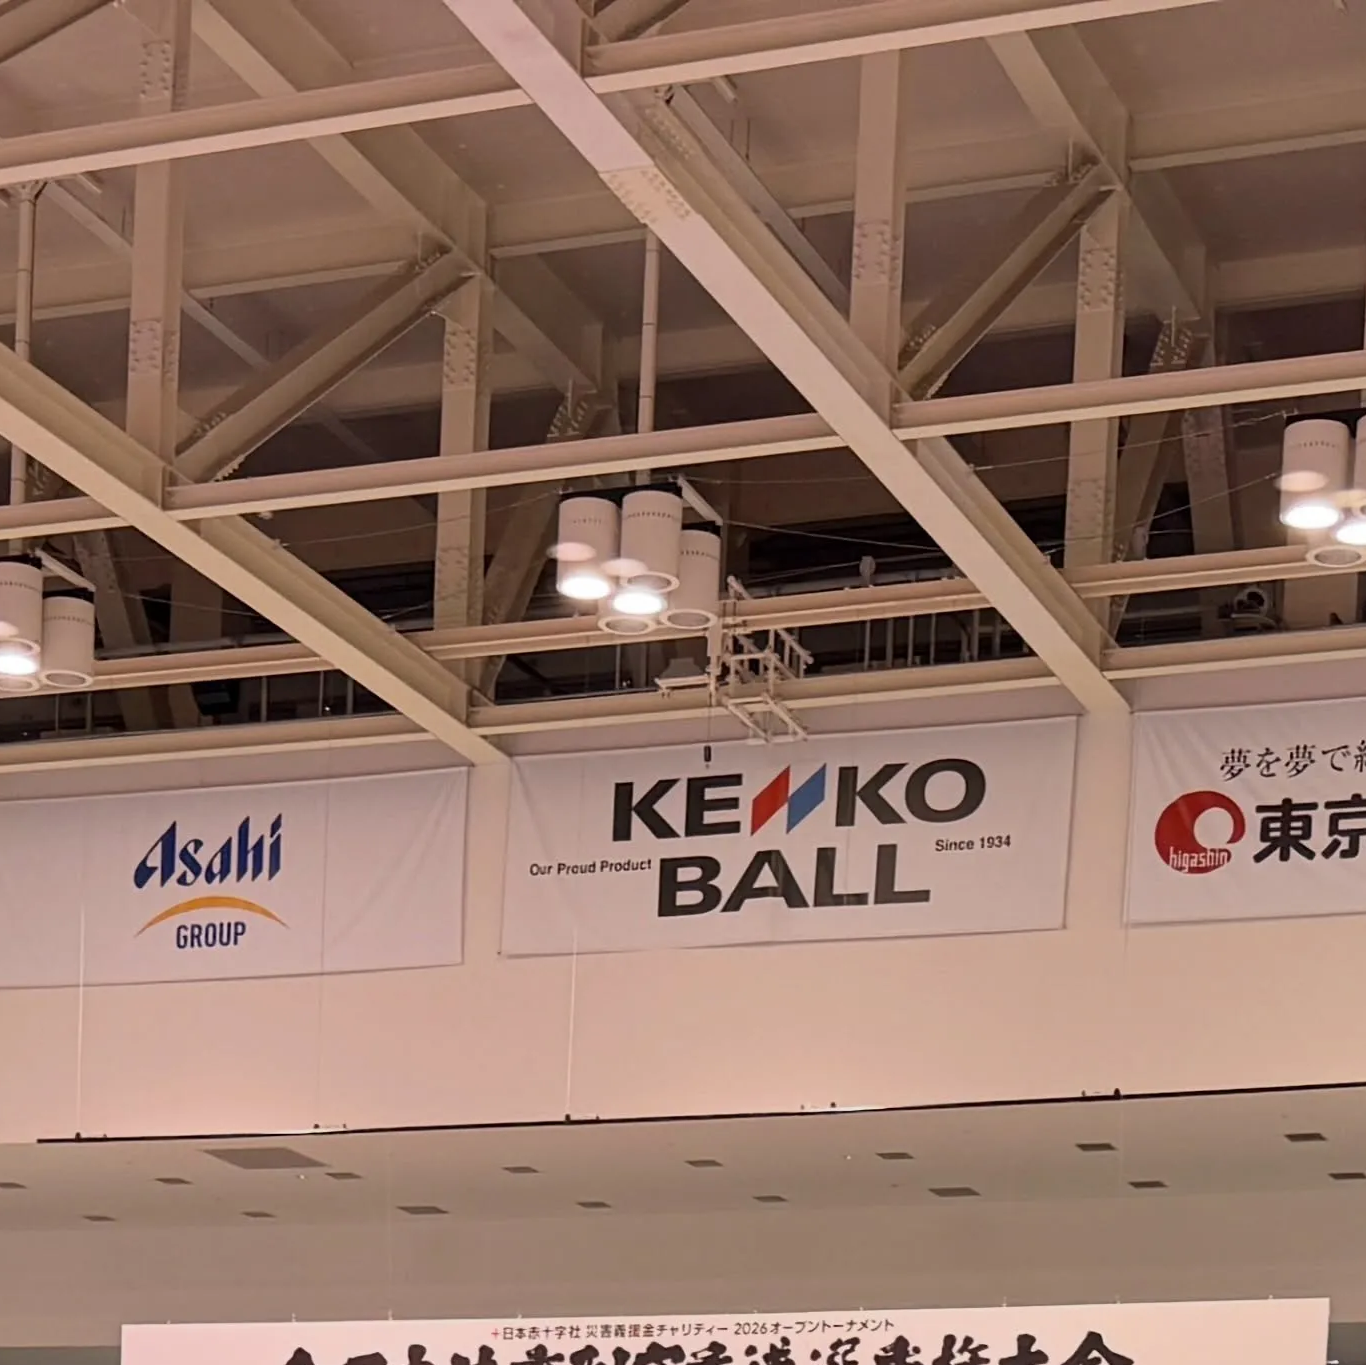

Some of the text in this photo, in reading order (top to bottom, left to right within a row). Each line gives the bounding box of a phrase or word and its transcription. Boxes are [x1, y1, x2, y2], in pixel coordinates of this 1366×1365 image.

[133, 813, 283, 889] Asahi
[934, 834, 1012, 852] Since 1934
[529, 858, 652, 877] Our Proud Product
[657, 843, 931, 918] BALL
[176, 921, 247, 949] GROUP
